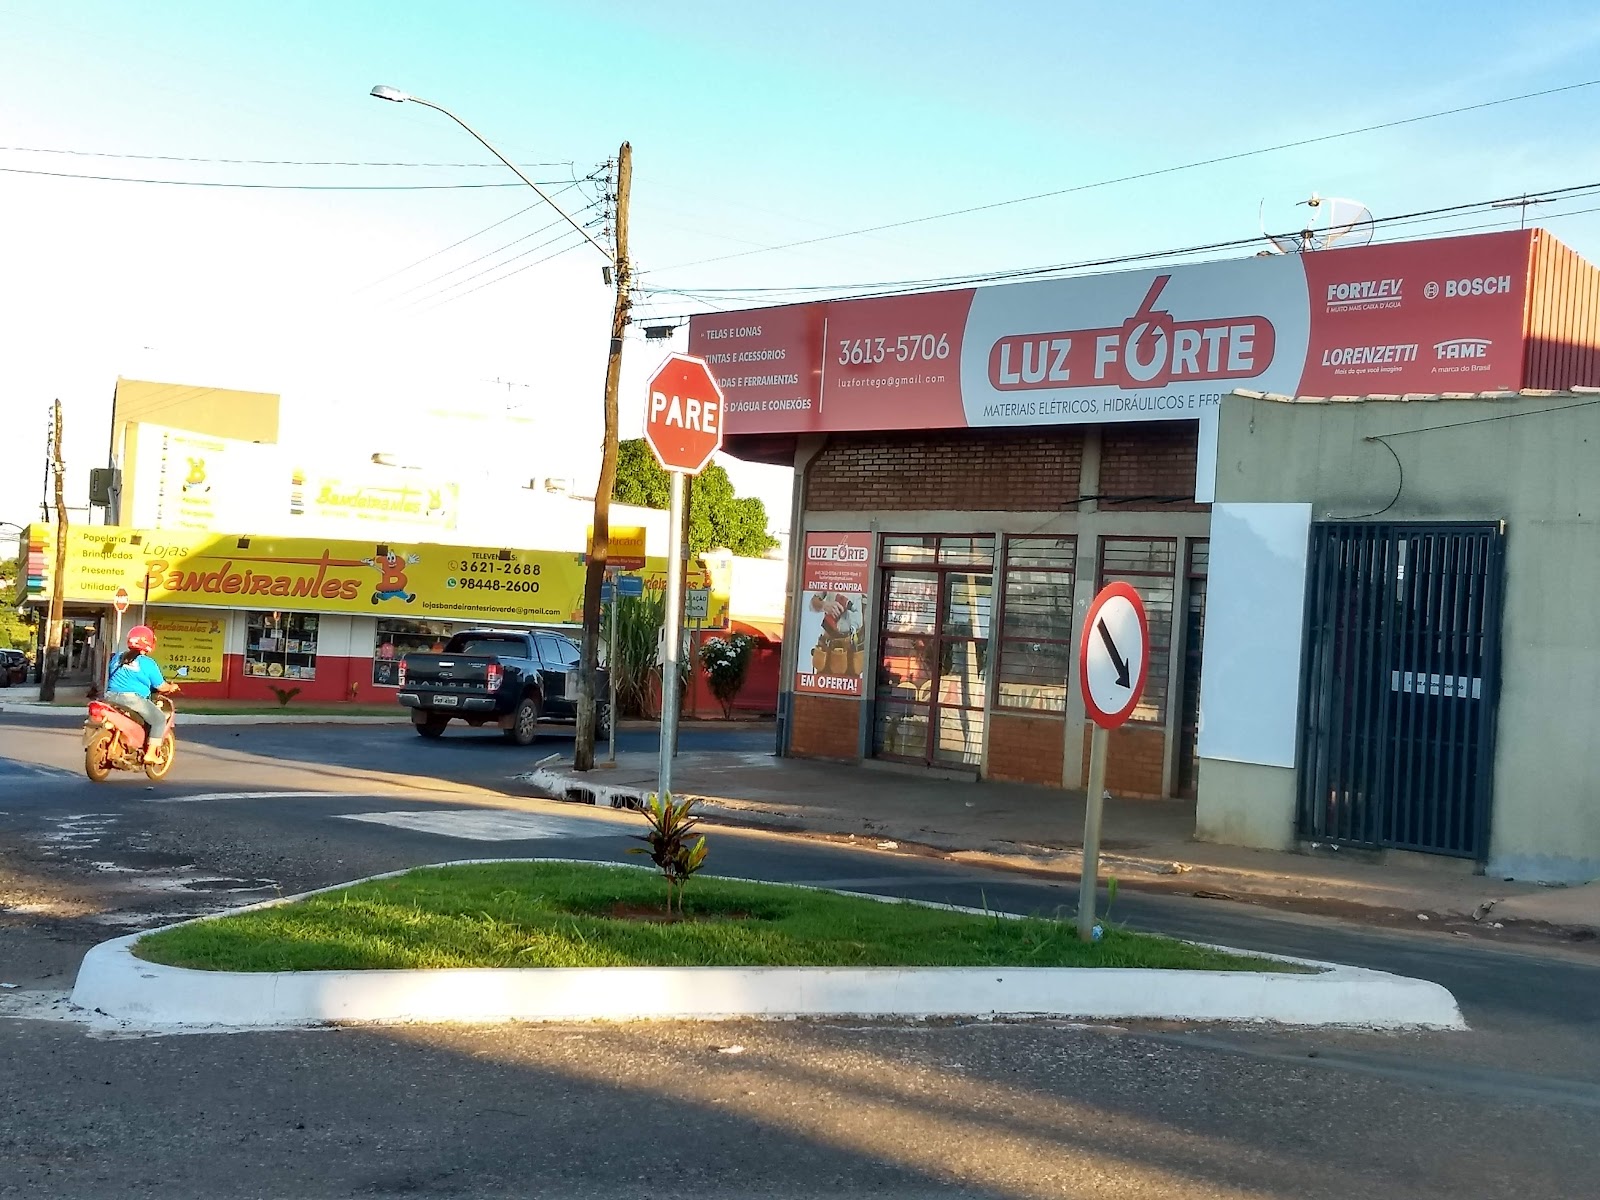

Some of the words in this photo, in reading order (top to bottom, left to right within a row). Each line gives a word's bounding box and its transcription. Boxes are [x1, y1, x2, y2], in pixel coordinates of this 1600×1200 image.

[1328, 278, 1403, 300] FORTLEV
[1445, 275, 1511, 297] BOSCH
[1349, 304, 1361, 312] MAIS
[706, 329, 728, 340] TELAS
[729, 328, 734, 338] E
[735, 326, 762, 338] LONAS
[705, 352, 731, 364] TINTAS
[732, 352, 737, 363] E
[738, 348, 786, 363] ACESSÓRIOS
[838, 333, 950, 366] 3613-5706
[999, 338, 1072, 384] LUZ
[1093, 321, 1256, 382] FORTE
[1322, 344, 1418, 366] LORENZETTI
[1435, 341, 1488, 359] FAME
[714, 377, 736, 388] ADAS
[737, 377, 742, 387] E
[743, 374, 799, 387] FERRAMENTAS
[837, 374, 945, 388] luzfortego@gmail.com
[762, 401, 767, 411] E
[768, 397, 812, 411] CONEXÕES
[983, 400, 1035, 417] MATERIAIS
[1038, 396, 1099, 415] ELÉTRICOS,
[1103, 393, 1184, 412] HIDRÁULICOS
[1188, 394, 1195, 409] E
[650, 391, 718, 434] PARE
[83, 533, 127, 543] Papelaria
[82, 549, 133, 560] Brinquedos
[143, 541, 190, 559] Lojas
[472, 551, 518, 562] TELEVENS:
[810, 547, 827, 558] LUZ
[831, 546, 865, 560] FORTE
[81, 565, 125, 576] Presentes
[136, 549, 363, 601] Bandeirantes
[460, 560, 541, 576] 3621-2688
[460, 577, 540, 593] 98448-2600
[808, 581, 828, 590] ENTRE
[828, 582, 833, 590] E
[833, 582, 863, 591] CONFIRA
[169, 654, 212, 663] 3621-2688
[408, 680, 485, 689] RANGER
[800, 674, 815, 687] EM
[817, 675, 858, 692] OFERTA!
